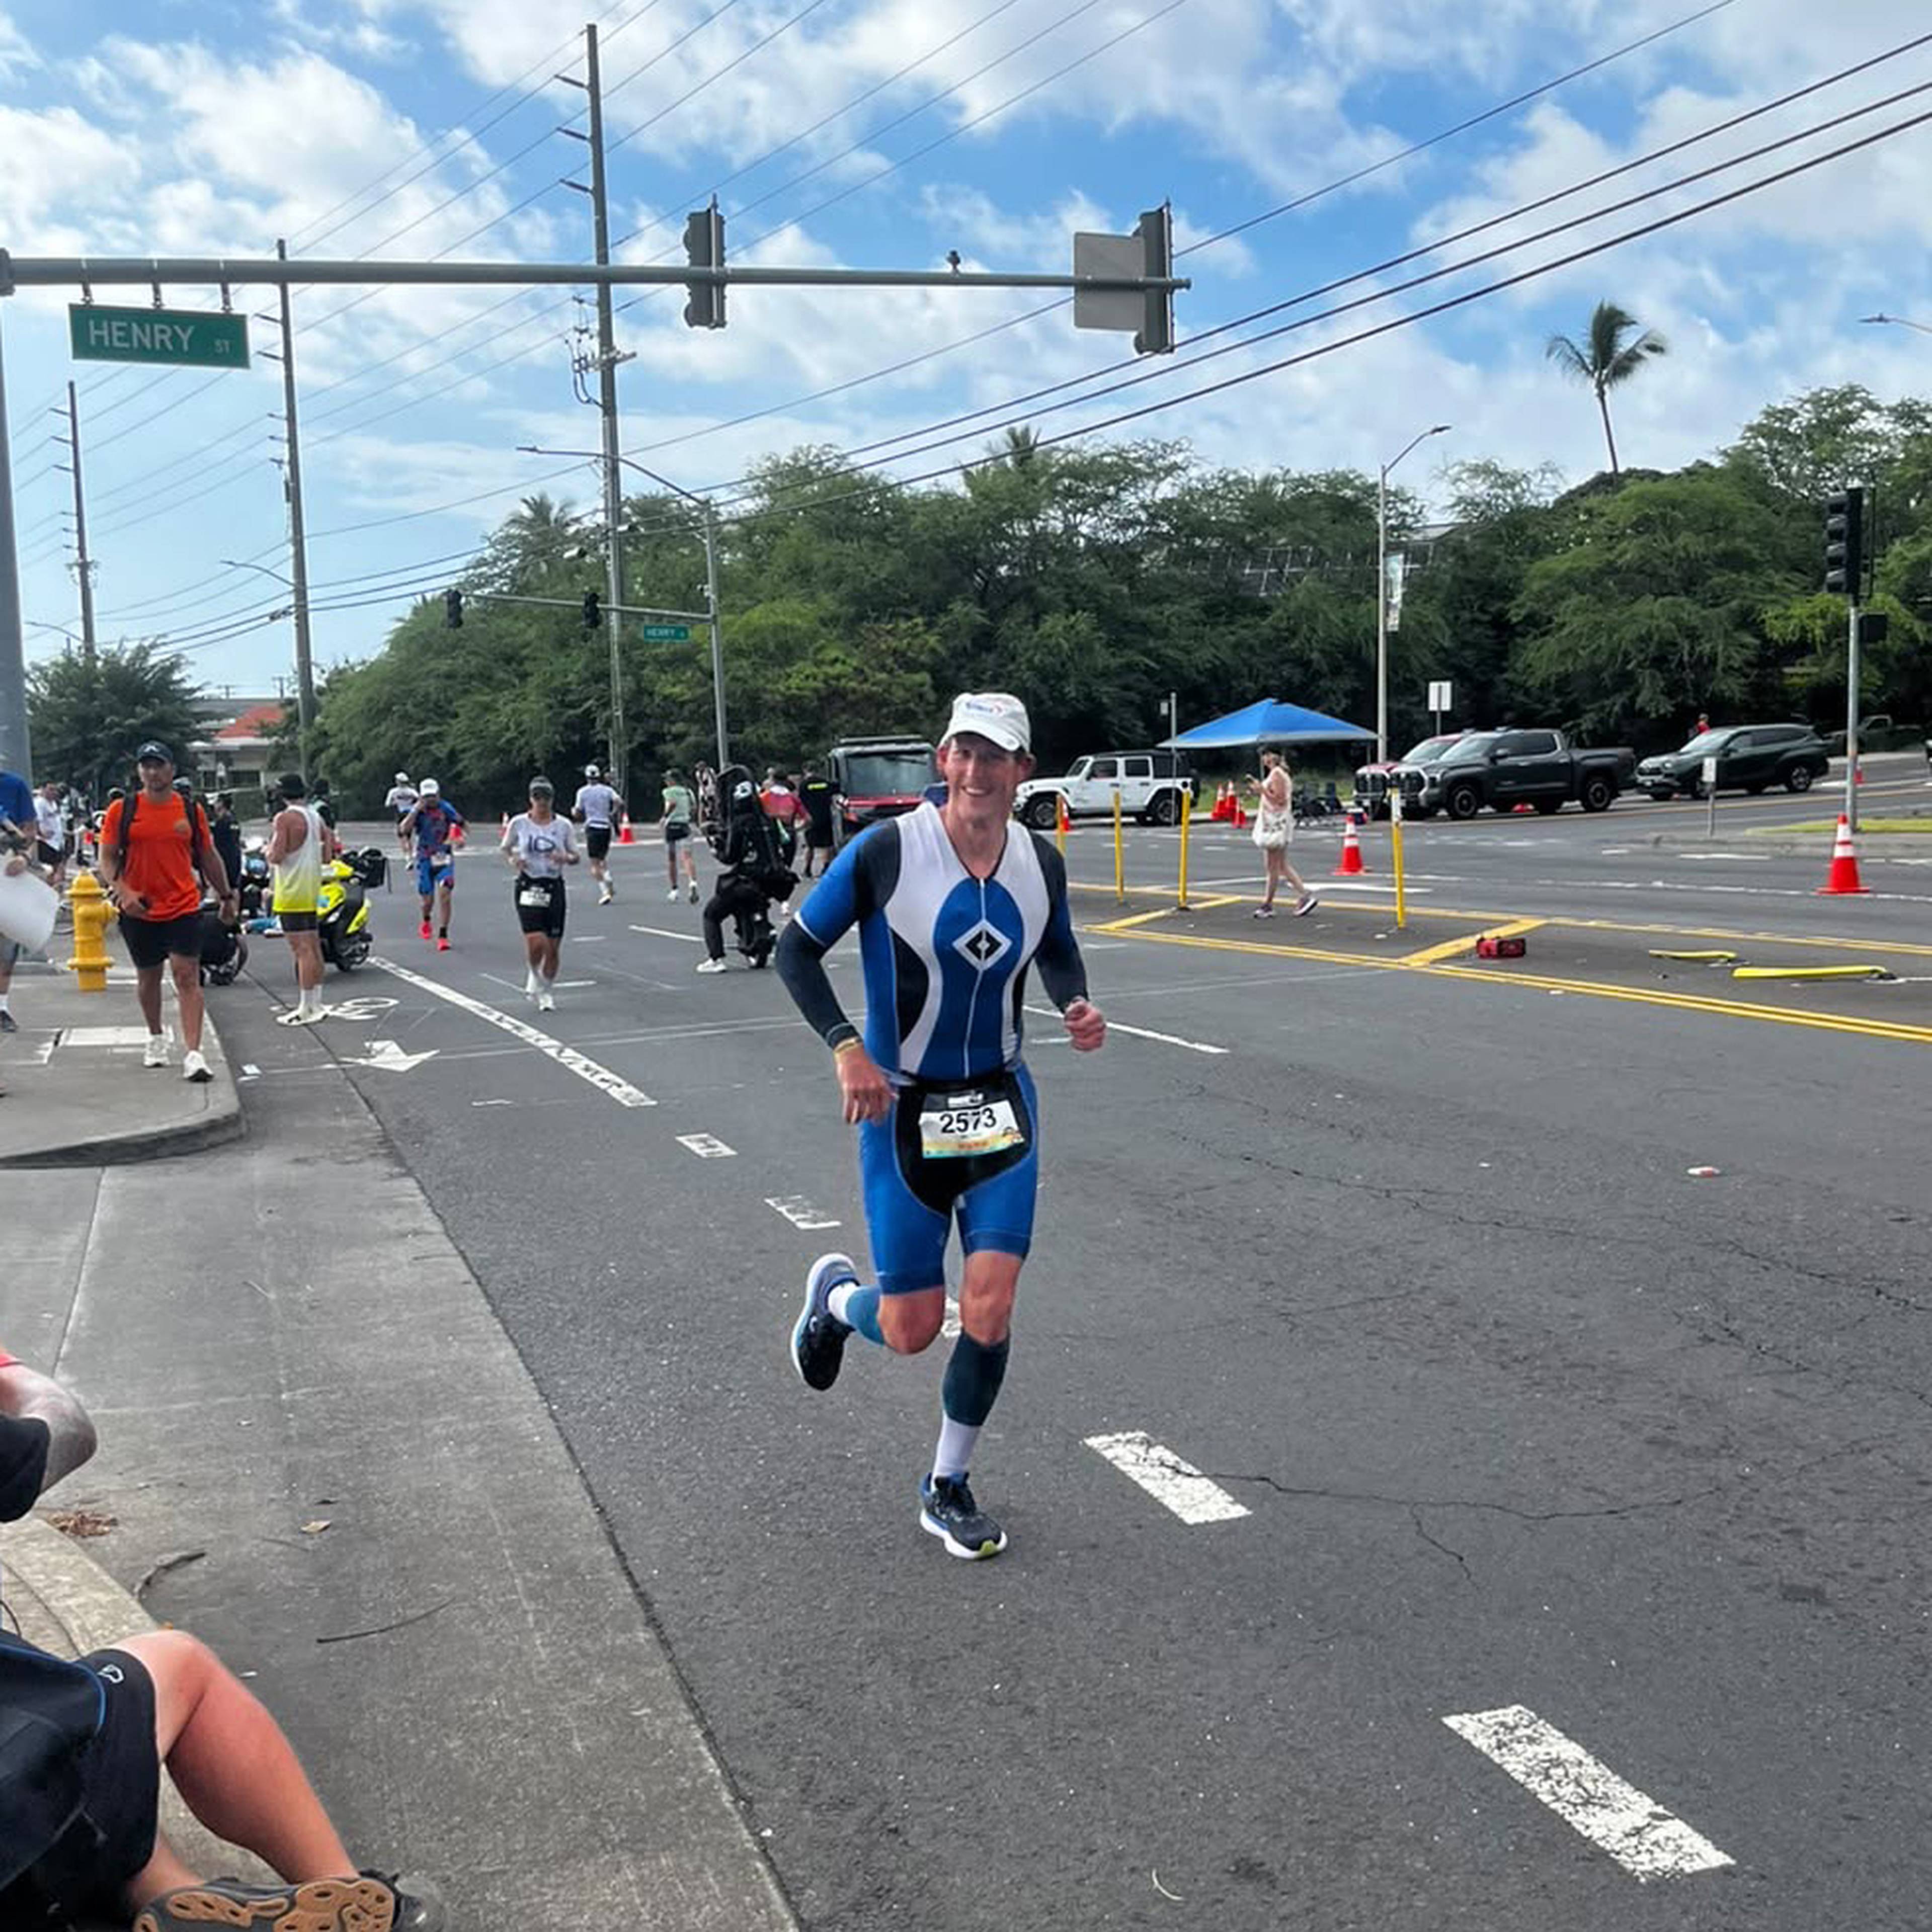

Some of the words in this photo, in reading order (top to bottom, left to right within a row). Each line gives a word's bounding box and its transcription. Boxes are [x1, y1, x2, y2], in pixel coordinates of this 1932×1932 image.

[89, 318, 195, 351] HENRY
[214, 339, 231, 353] ST
[940, 1107, 997, 1133] 2573
